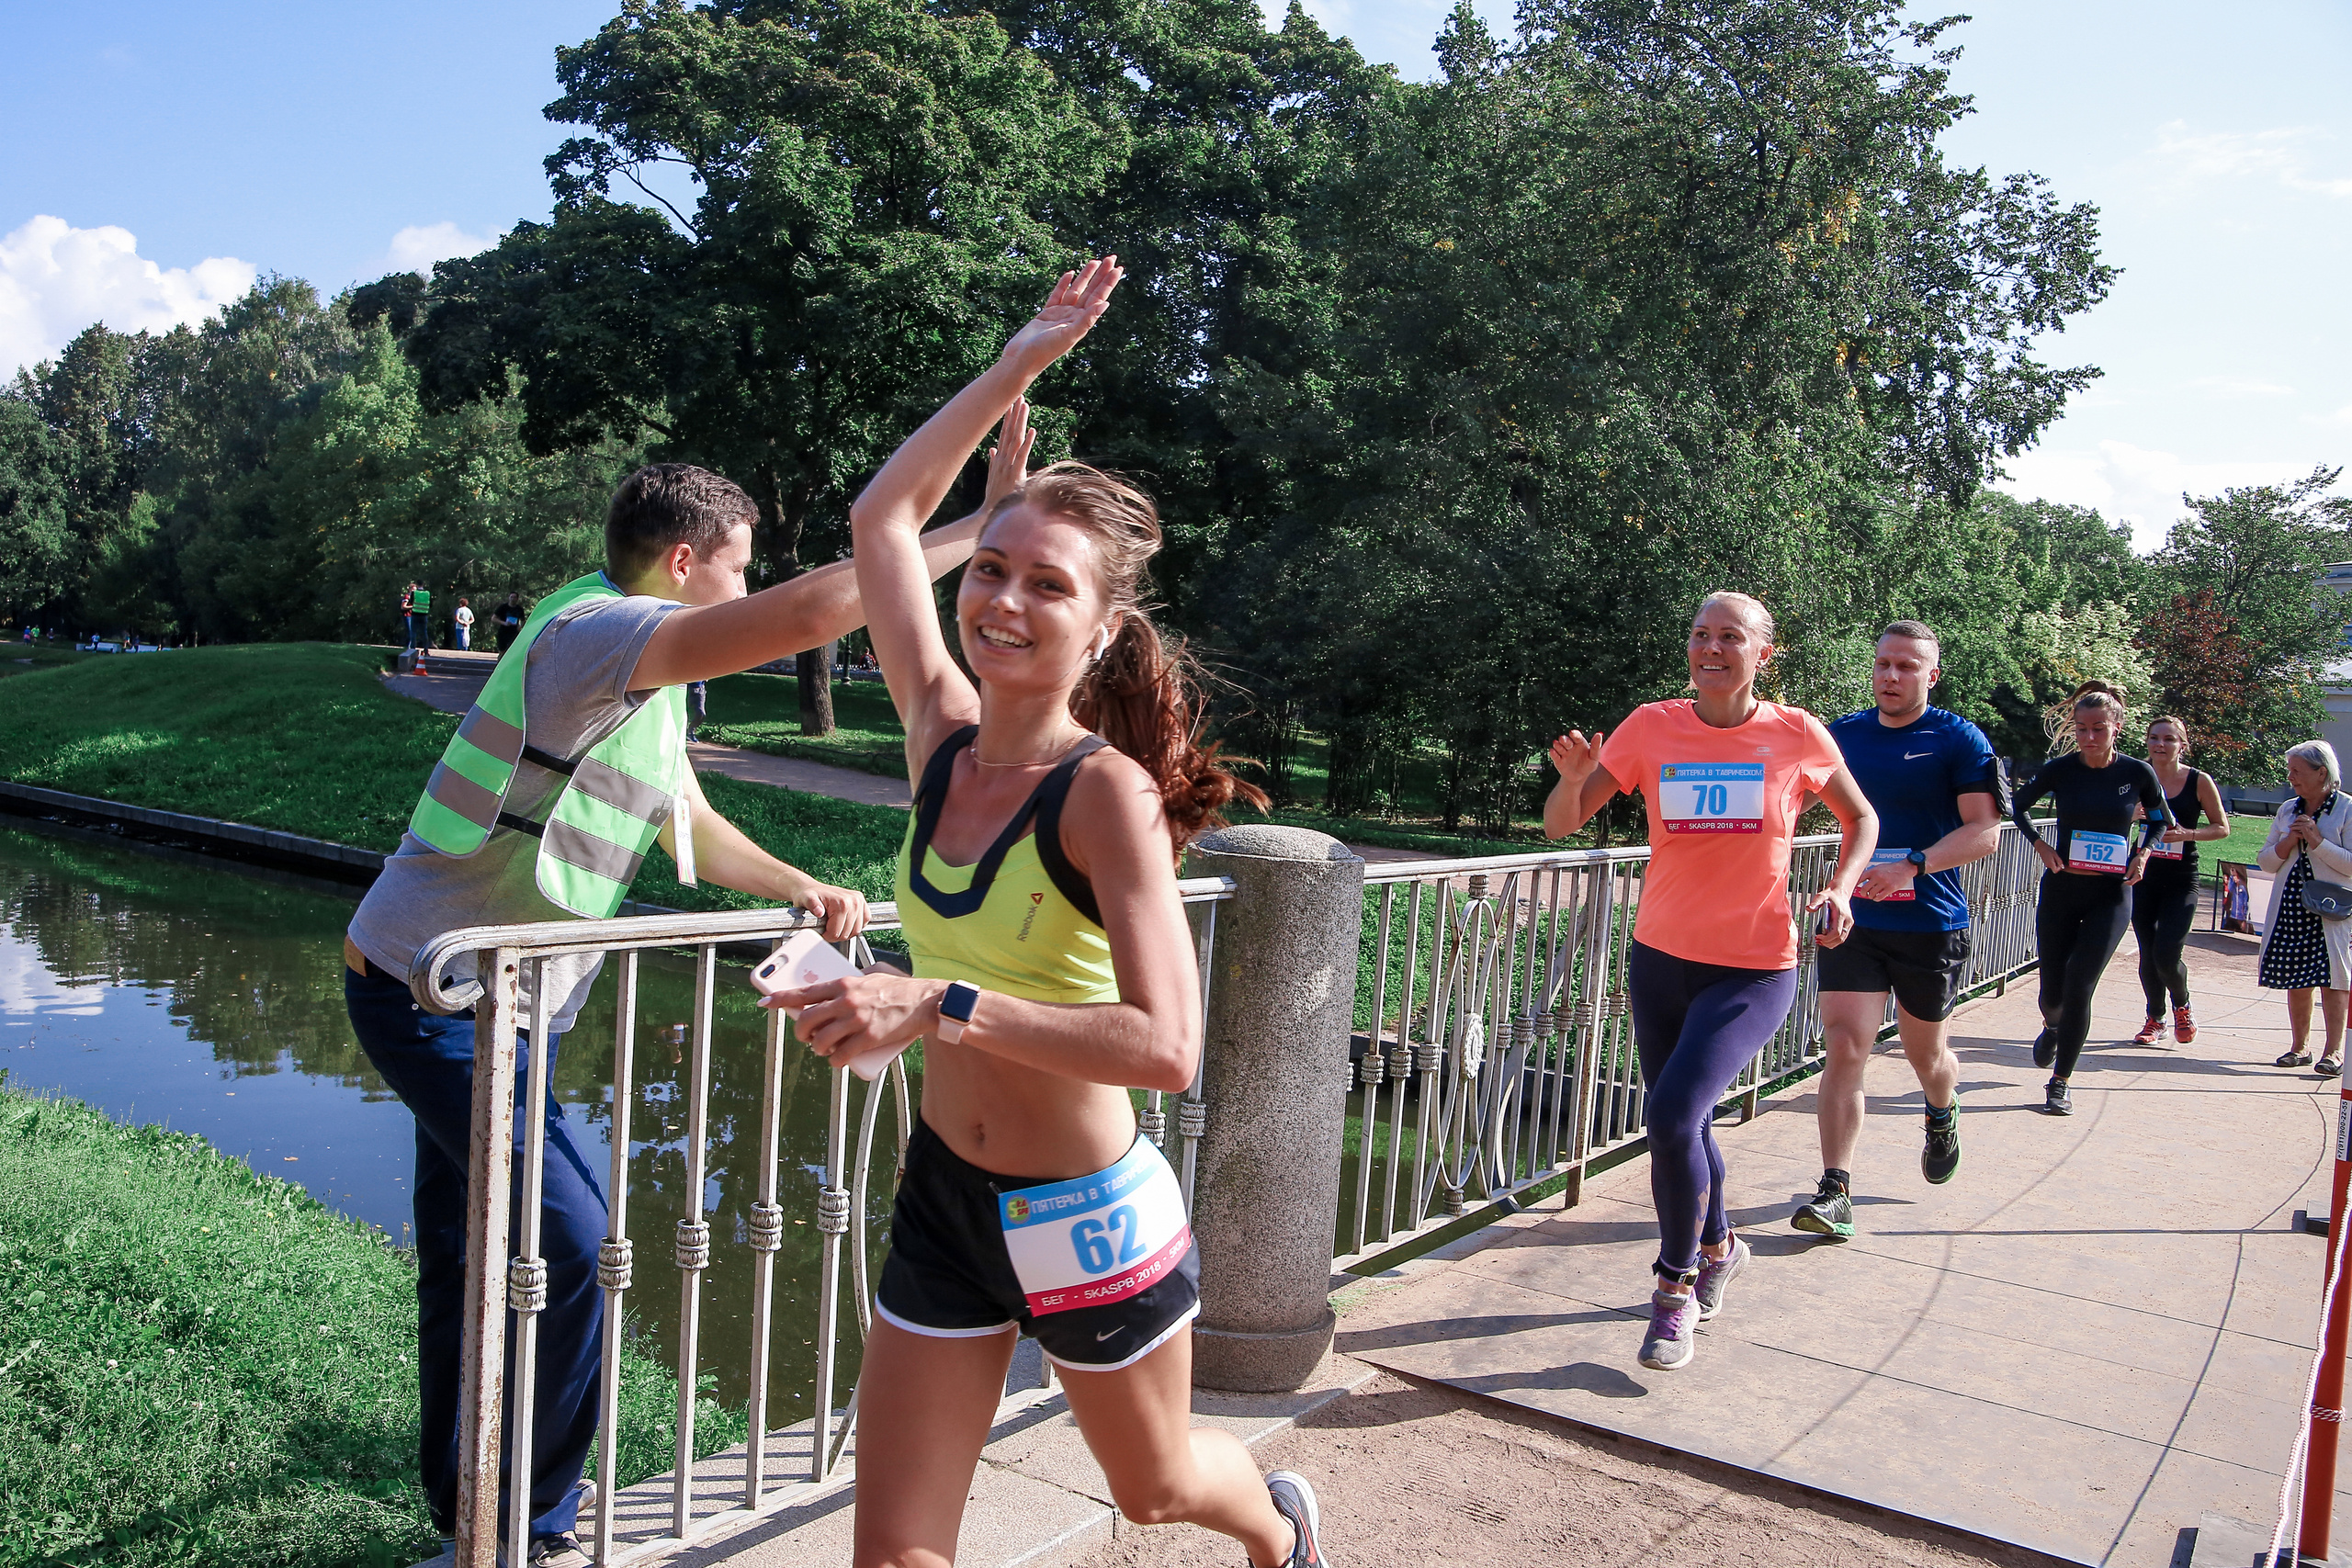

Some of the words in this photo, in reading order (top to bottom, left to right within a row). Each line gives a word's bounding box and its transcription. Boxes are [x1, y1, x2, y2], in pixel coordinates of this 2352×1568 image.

[1692, 784, 1727, 816] 70
[2084, 843, 2114, 863] 152
[1016, 904, 1038, 942] Reebok
[1031, 1191, 1086, 1213] ПЯТЕРКА
[1088, 1188, 1099, 1201] В
[1070, 1204, 1148, 1275] 62
[1041, 1293, 1066, 1306] БЕГ
[1084, 1277, 1136, 1299] 5KASPB
[1136, 1260, 1161, 1283] 2018
